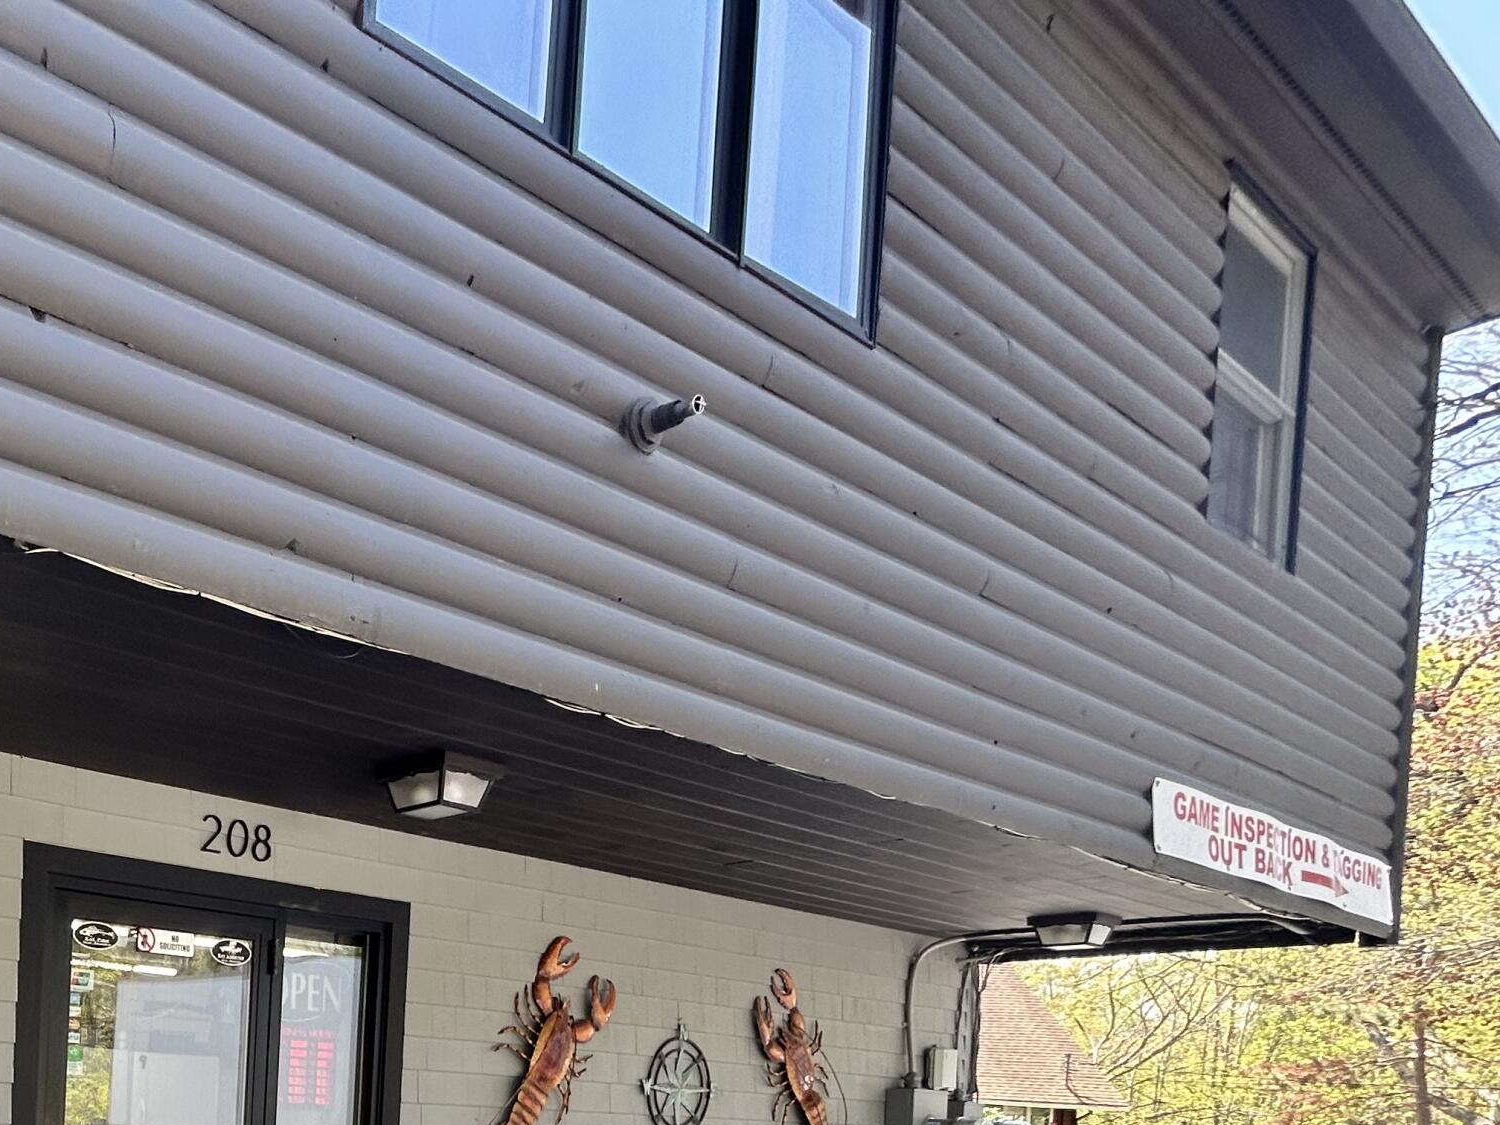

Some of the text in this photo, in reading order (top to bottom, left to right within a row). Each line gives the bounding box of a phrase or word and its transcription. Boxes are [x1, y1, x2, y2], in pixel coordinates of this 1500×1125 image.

[200, 814, 272, 862] 208
[1174, 791, 1220, 834] GAME
[1321, 843, 1331, 869] &
[1208, 835, 1248, 870] OUT
[171, 935, 180, 943] NO
